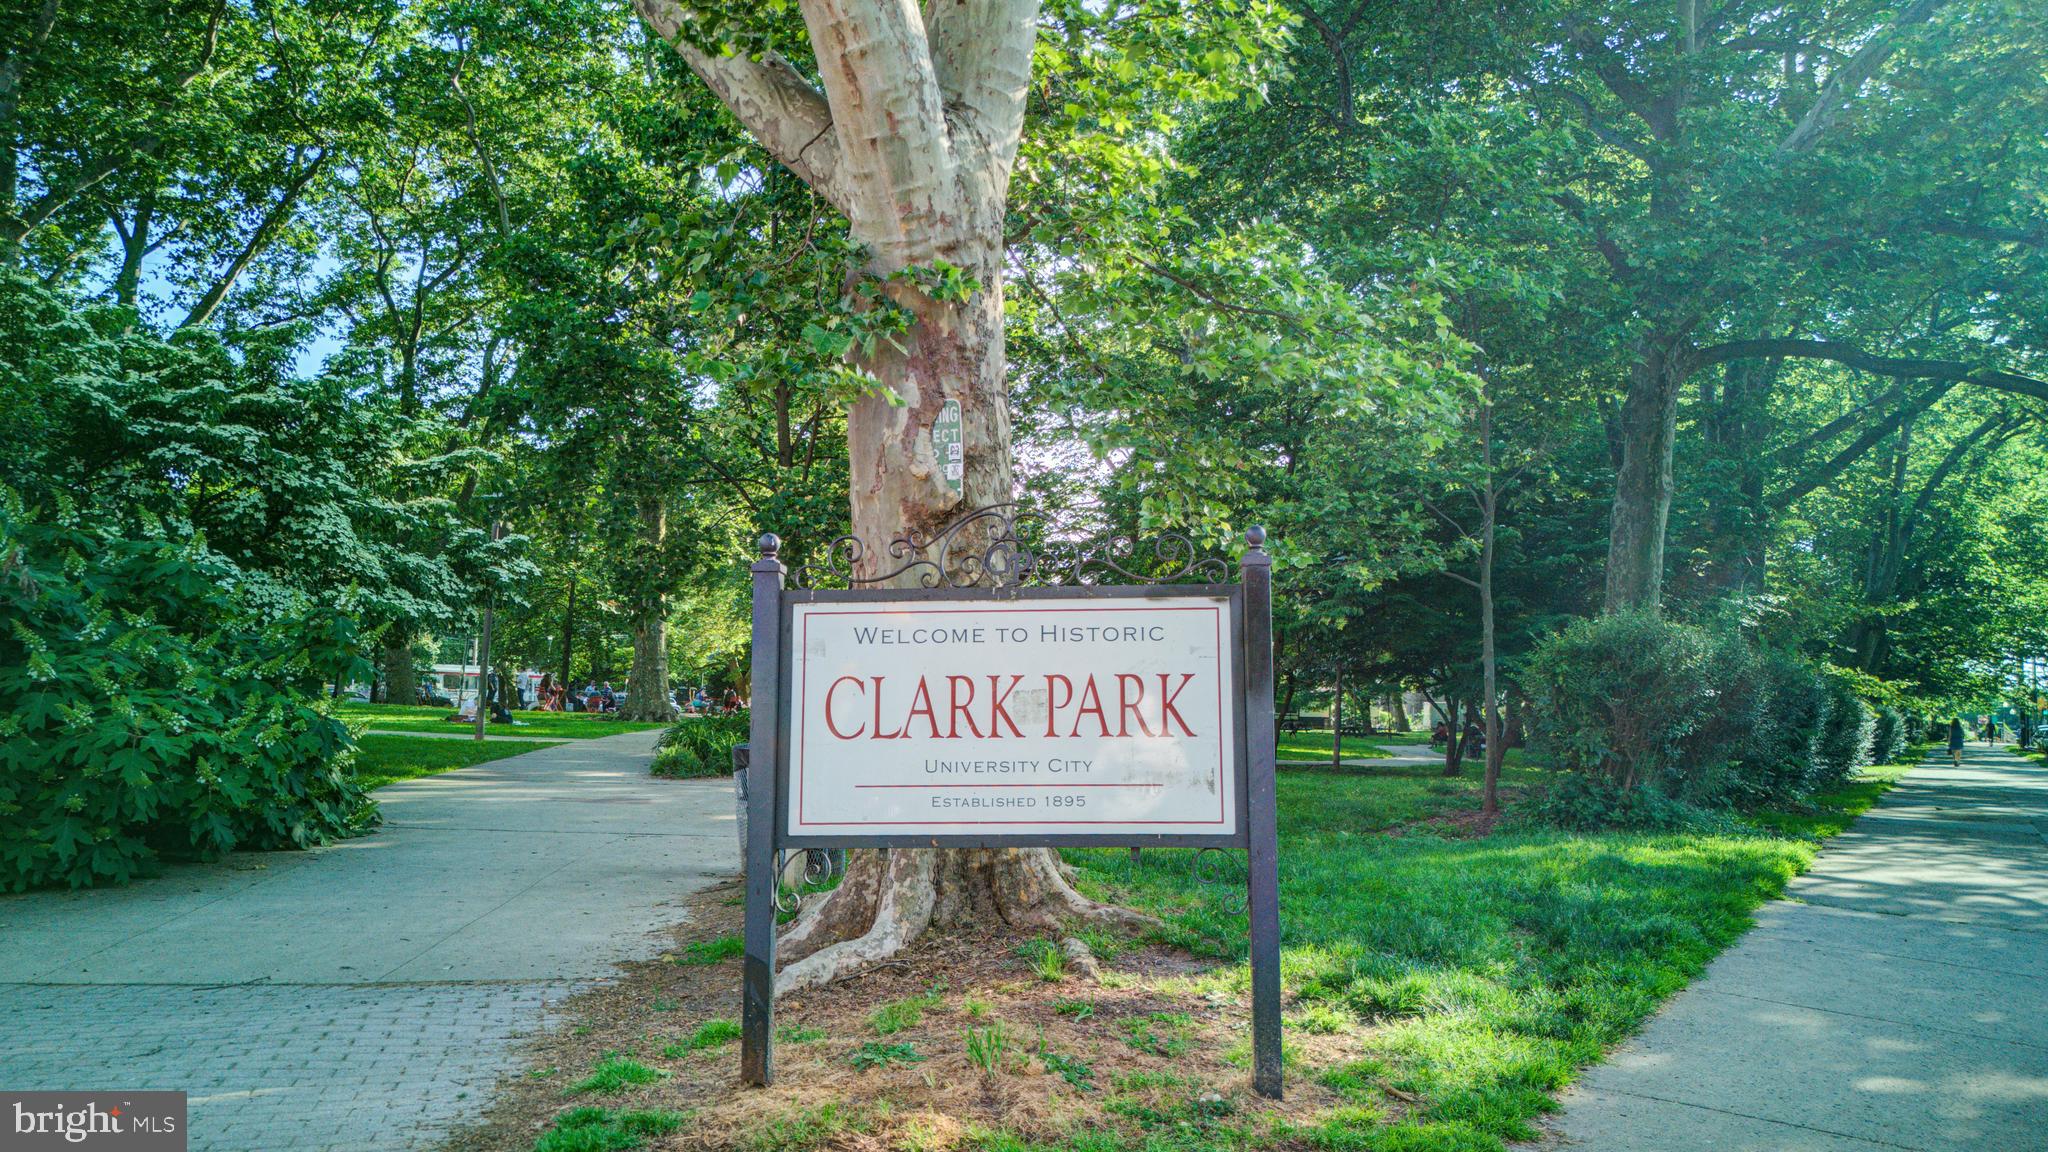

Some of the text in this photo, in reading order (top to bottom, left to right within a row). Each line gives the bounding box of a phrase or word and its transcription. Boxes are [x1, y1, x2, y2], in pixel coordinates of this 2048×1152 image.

[854, 625, 1165, 644] WELCOME TO HISTORIC
[825, 673, 1197, 740] CLARK PARK
[924, 759, 1093, 774] UNIVERSITY CITY
[931, 795, 1086, 809] ESTABLISHED 1895
